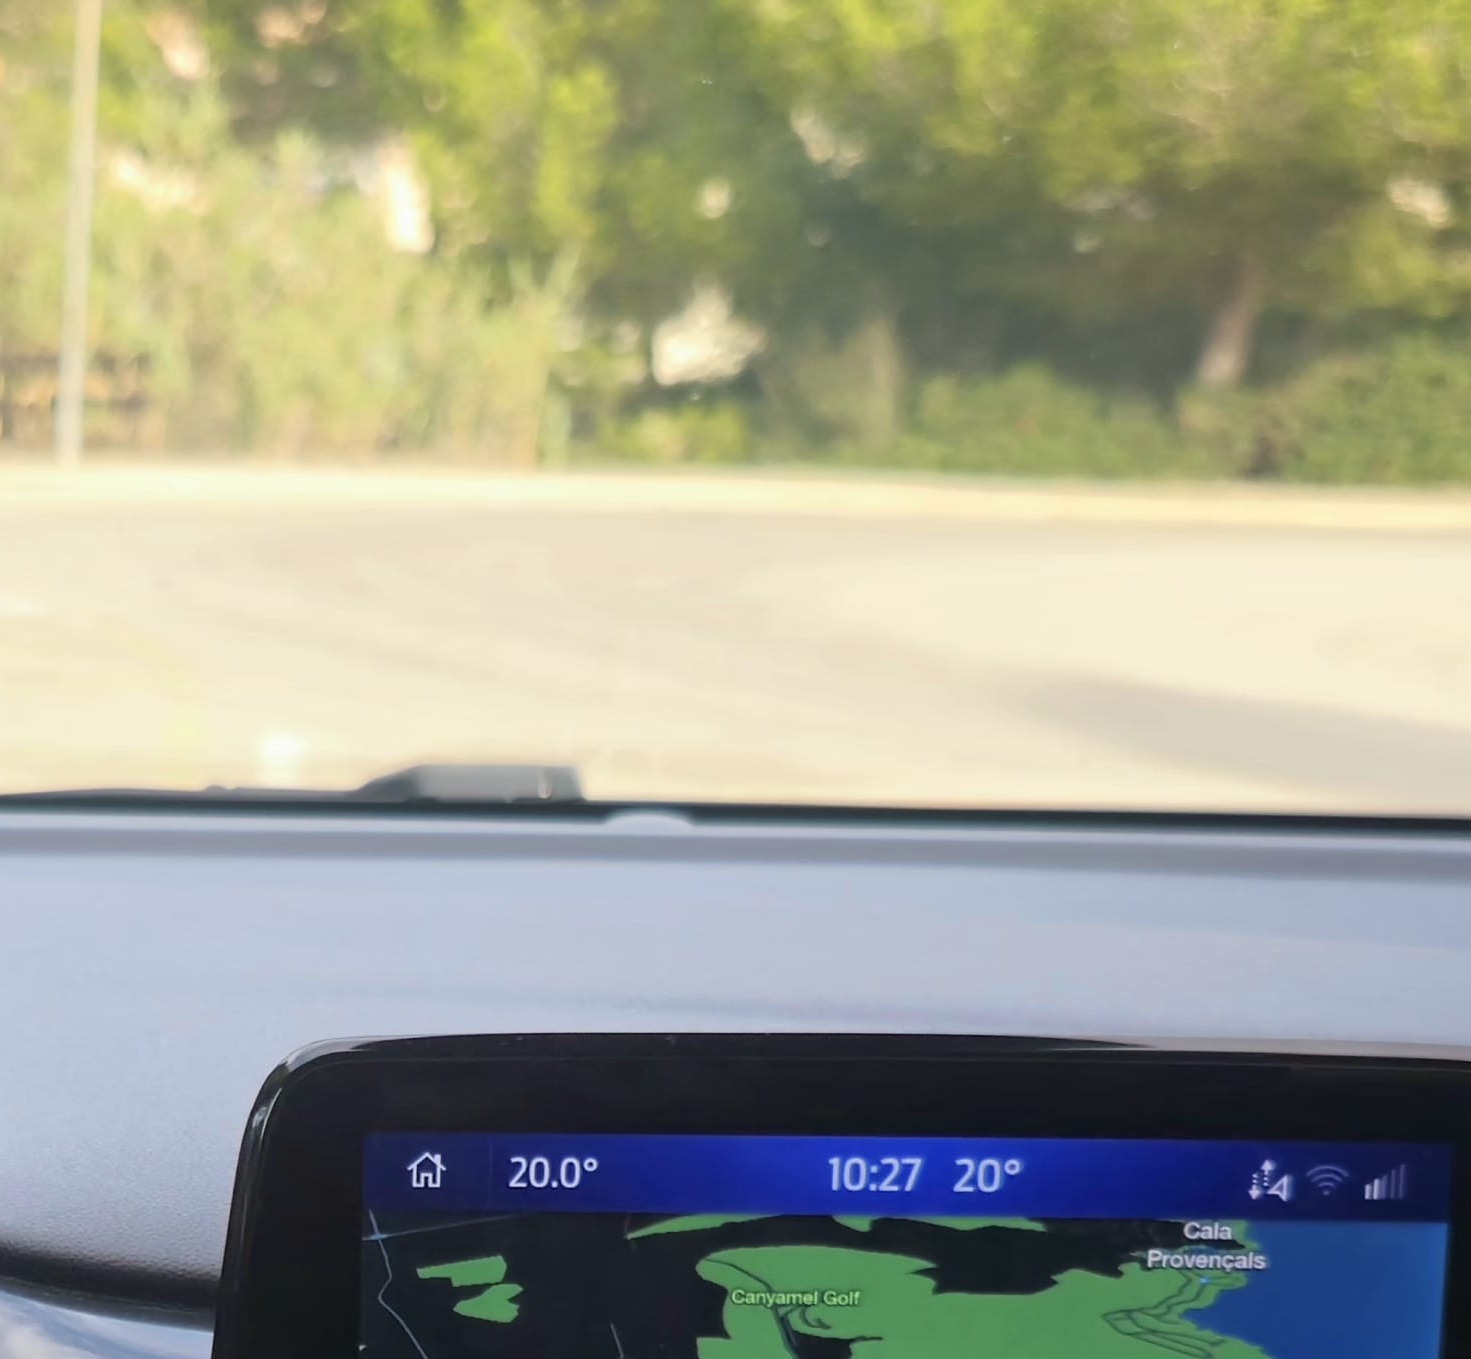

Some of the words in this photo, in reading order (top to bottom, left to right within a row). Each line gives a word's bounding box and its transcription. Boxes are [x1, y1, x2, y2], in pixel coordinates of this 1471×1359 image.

[508, 1157, 598, 1189] 20.0°
[828, 1157, 922, 1192] 10:27
[953, 1158, 1021, 1193] 20°
[1183, 1222, 1232, 1241] Cala
[1146, 1250, 1266, 1271] Provençals
[731, 1289, 818, 1307] Canyamel
[823, 1290, 860, 1306] Golf
